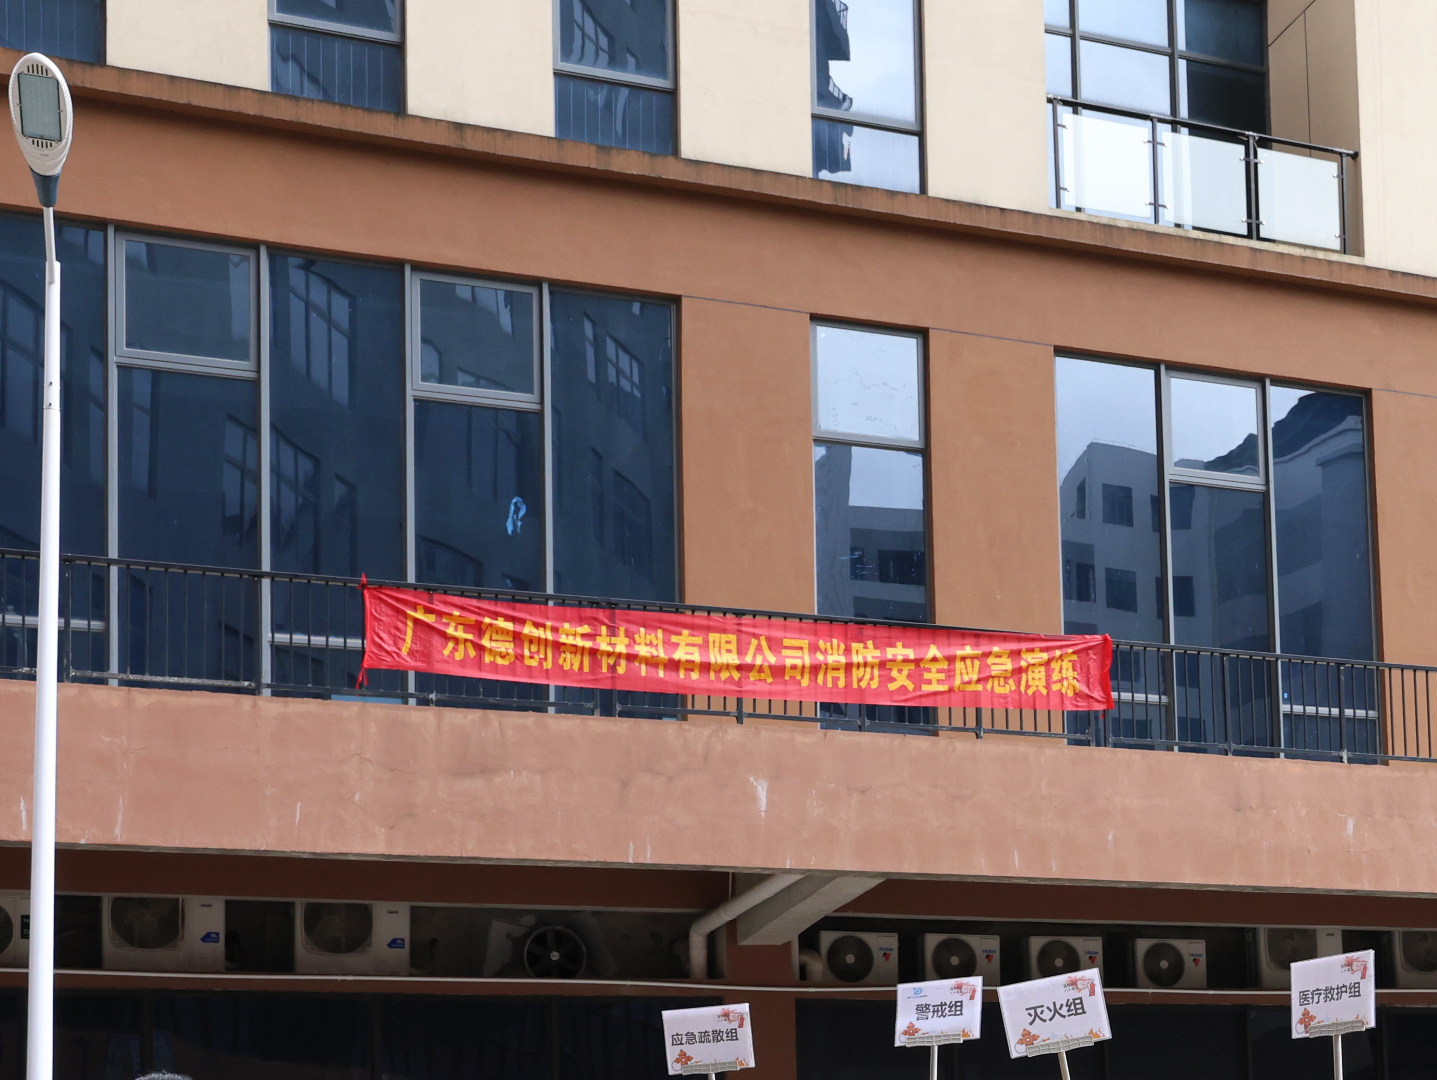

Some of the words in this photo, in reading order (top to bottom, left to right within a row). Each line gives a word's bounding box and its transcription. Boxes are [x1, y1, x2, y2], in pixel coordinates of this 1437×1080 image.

[402, 605, 1080, 697] 广东德创新材料有限公司消防安全应急演练
[1299, 982, 1361, 1006] 医疗救护组
[915, 1000, 964, 1021] 警戒组
[1025, 997, 1086, 1026] 灭火组
[671, 1028, 739, 1046] 应急疏散组
